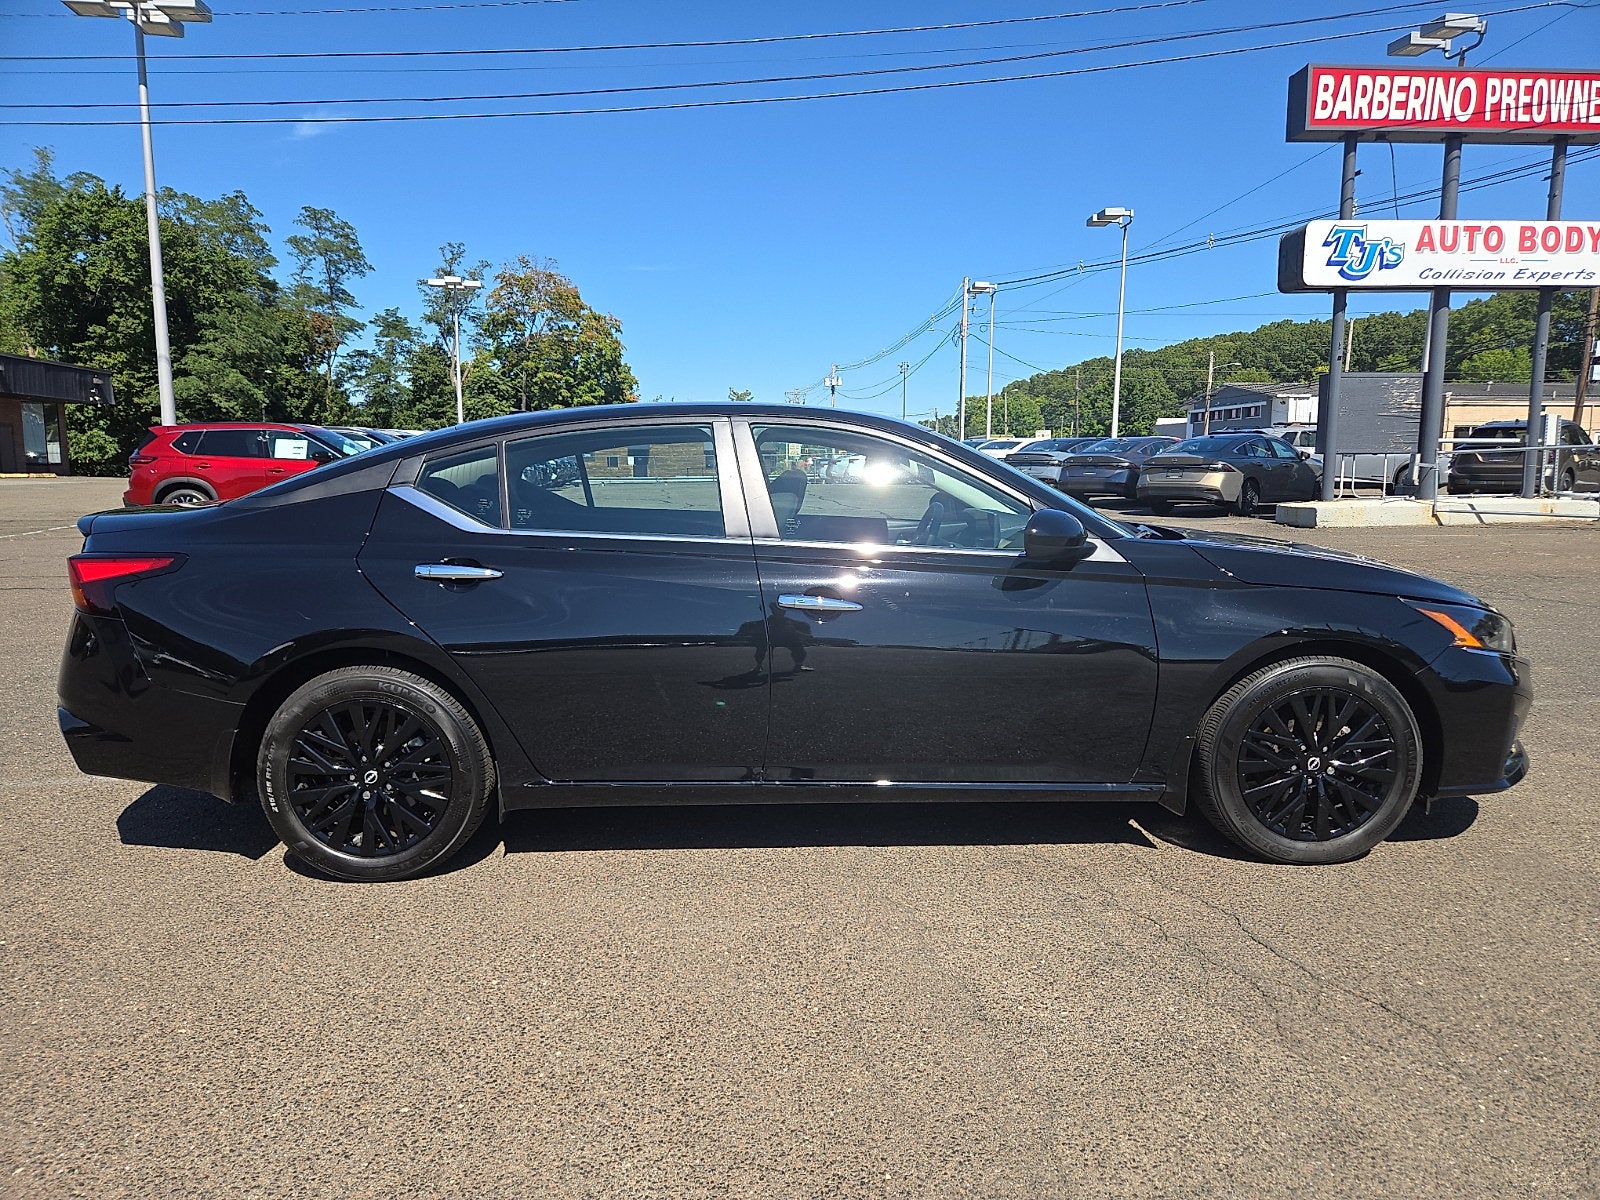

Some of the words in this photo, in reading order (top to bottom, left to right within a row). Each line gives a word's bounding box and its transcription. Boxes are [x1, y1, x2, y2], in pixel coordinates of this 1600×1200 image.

[1314, 74, 1478, 122] BARBERINO
[1484, 77, 1600, 124] PREOWNE
[1322, 224, 1406, 281] TJ's
[1415, 225, 1505, 254] AUTO
[1518, 226, 1600, 254] BODY
[1419, 267, 1505, 280] Collision
[1512, 268, 1596, 282] Experts
